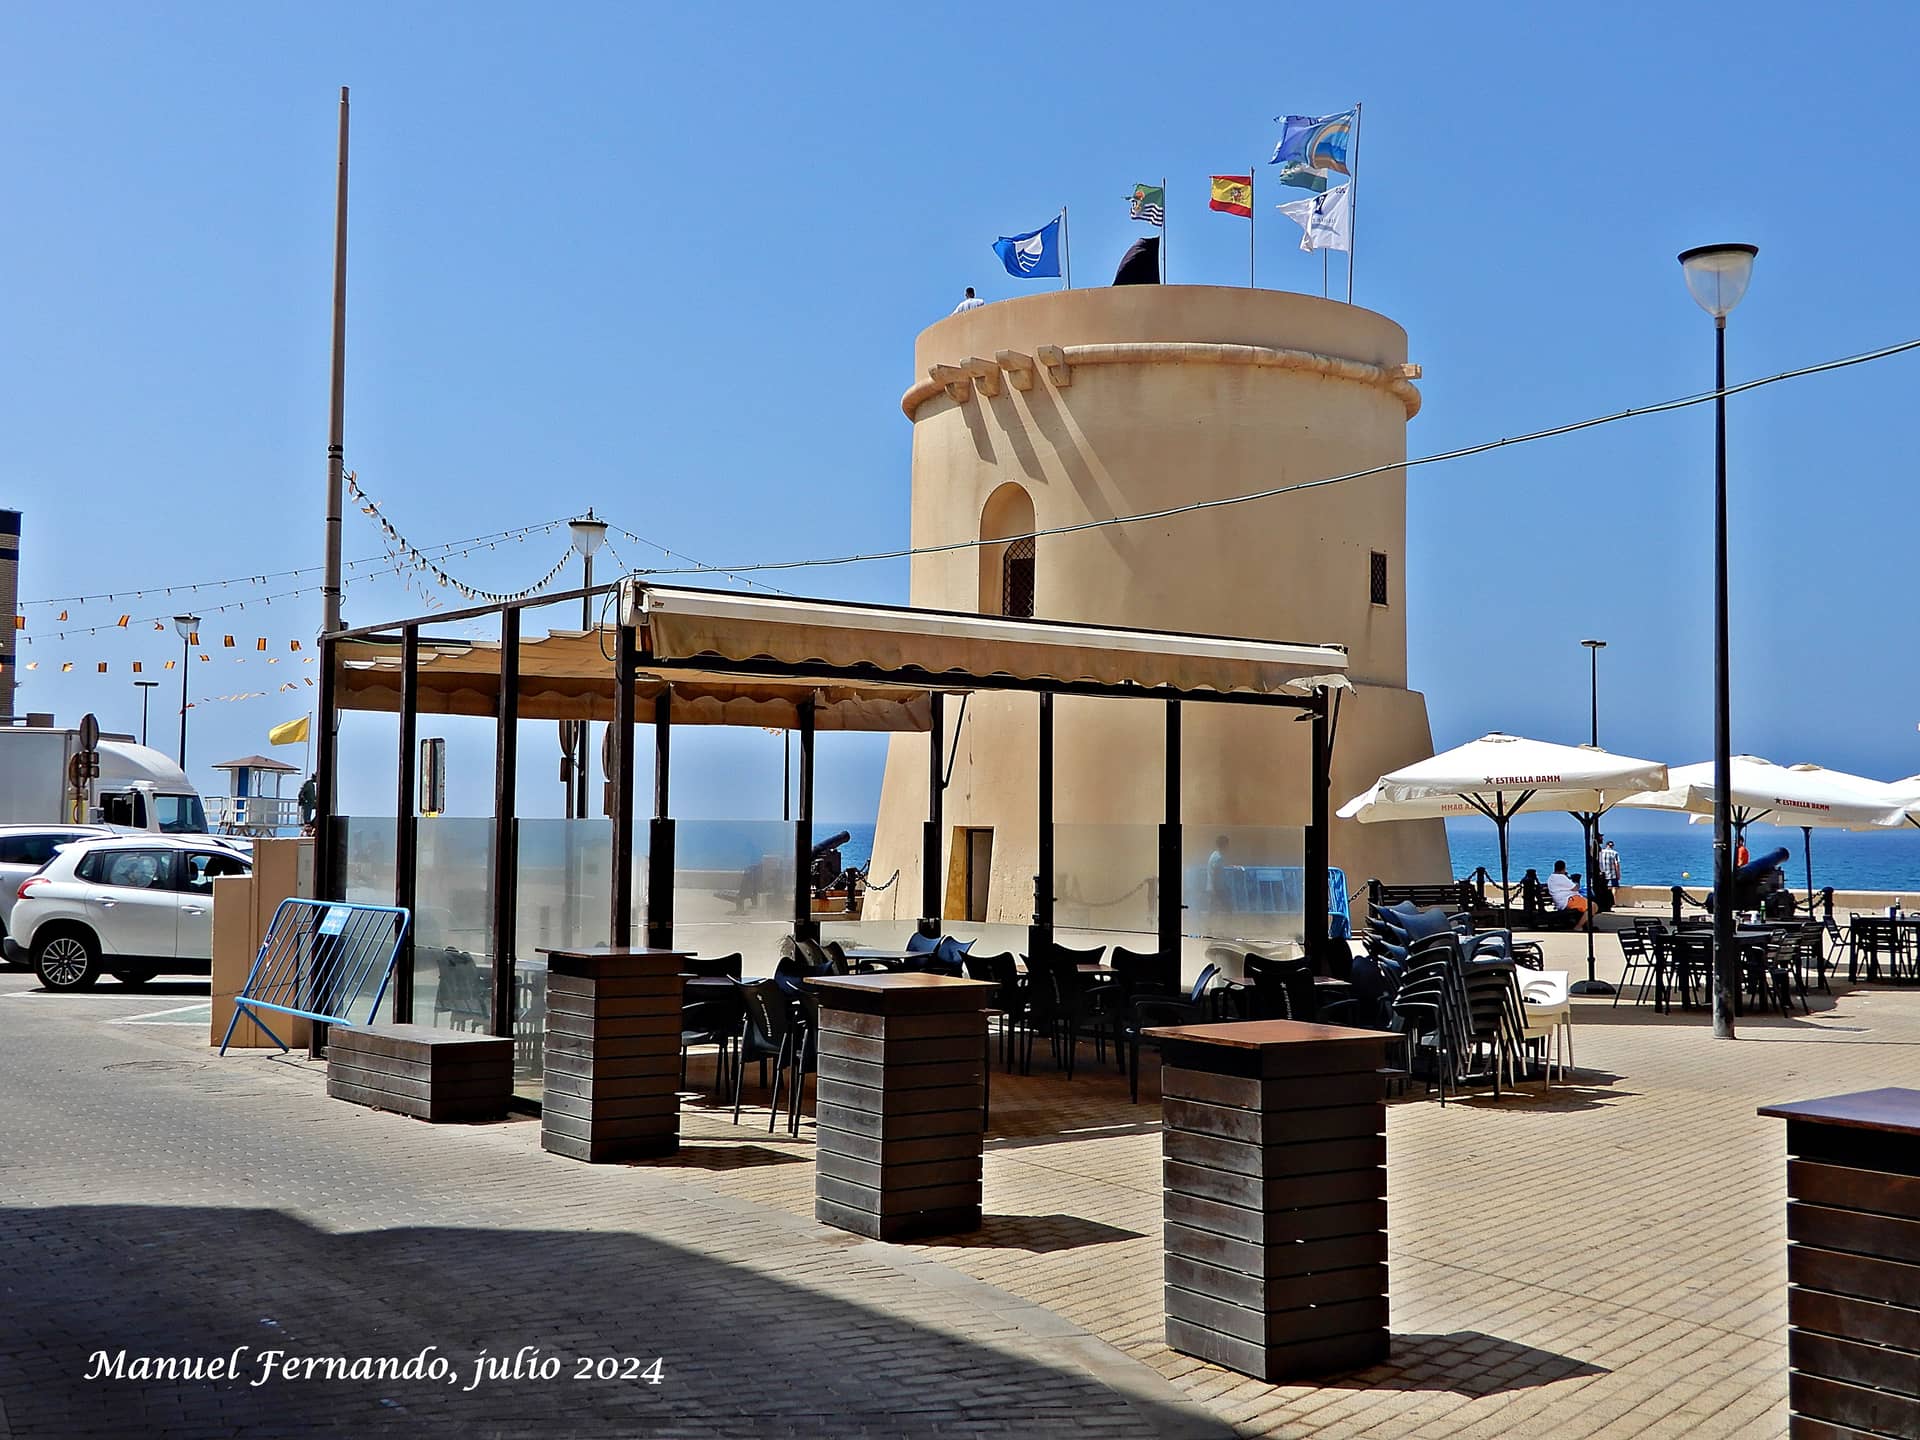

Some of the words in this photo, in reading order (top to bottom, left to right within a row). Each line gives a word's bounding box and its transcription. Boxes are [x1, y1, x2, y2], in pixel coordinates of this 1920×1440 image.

[1495, 776, 1534, 784] ESTRELLA
[1535, 775, 1561, 783] DAMM
[1782, 799, 1811, 808] ESTRELLA
[1811, 803, 1830, 811] DAMM
